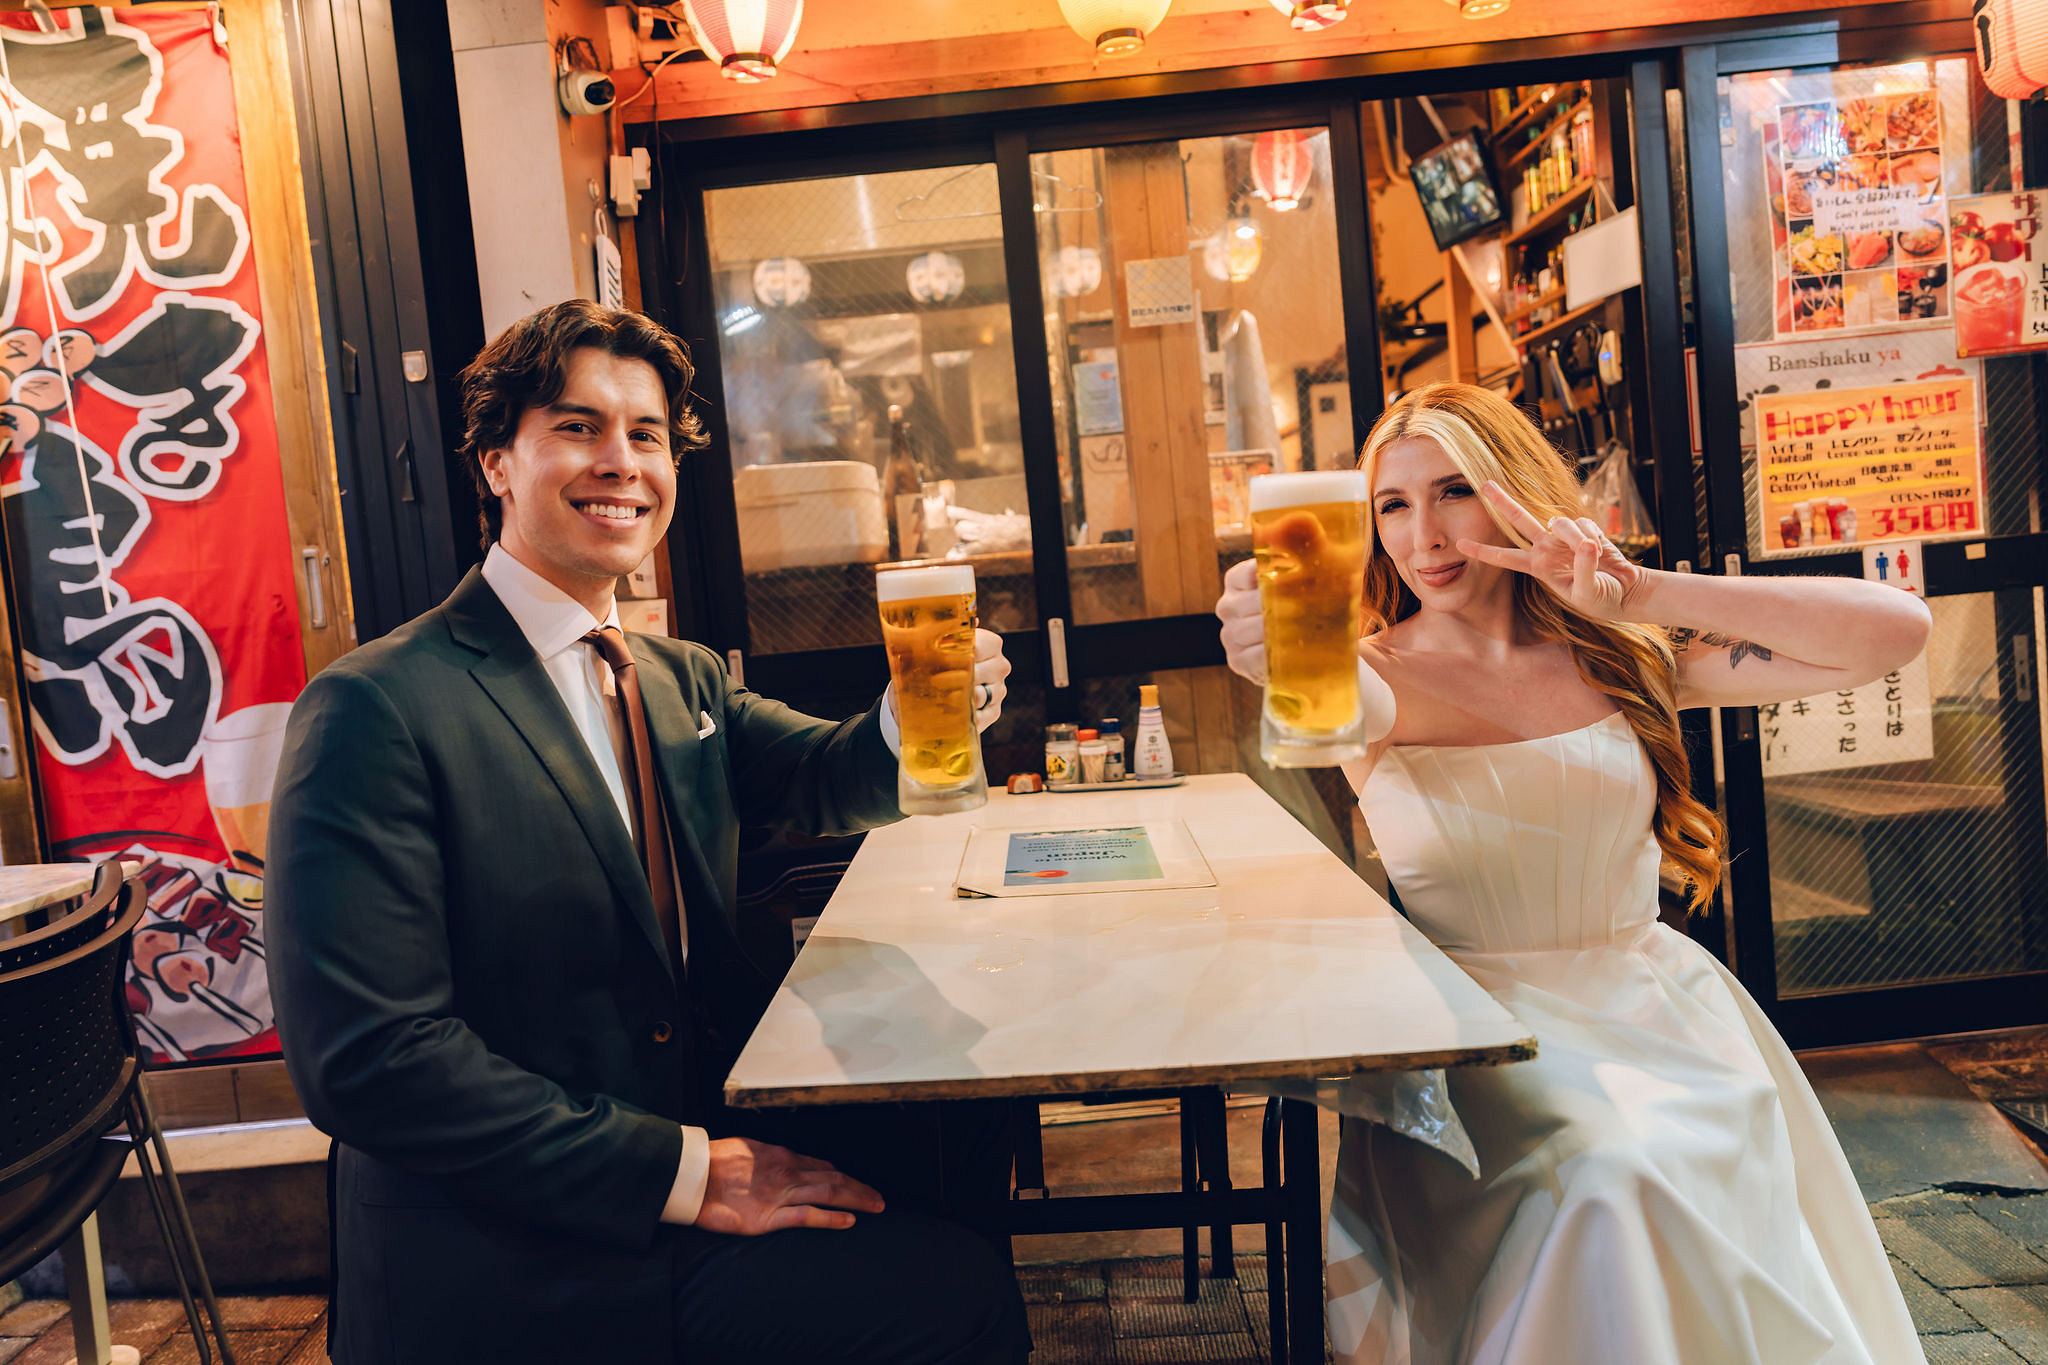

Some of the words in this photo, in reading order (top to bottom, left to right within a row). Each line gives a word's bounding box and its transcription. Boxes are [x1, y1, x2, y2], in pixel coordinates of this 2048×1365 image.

[1768, 352, 1871, 373] Banshaku
[1878, 349, 1902, 366] ya
[1766, 399, 1877, 442] Happy
[1882, 389, 1962, 424] hour
[1872, 500, 1976, 537] 350円
